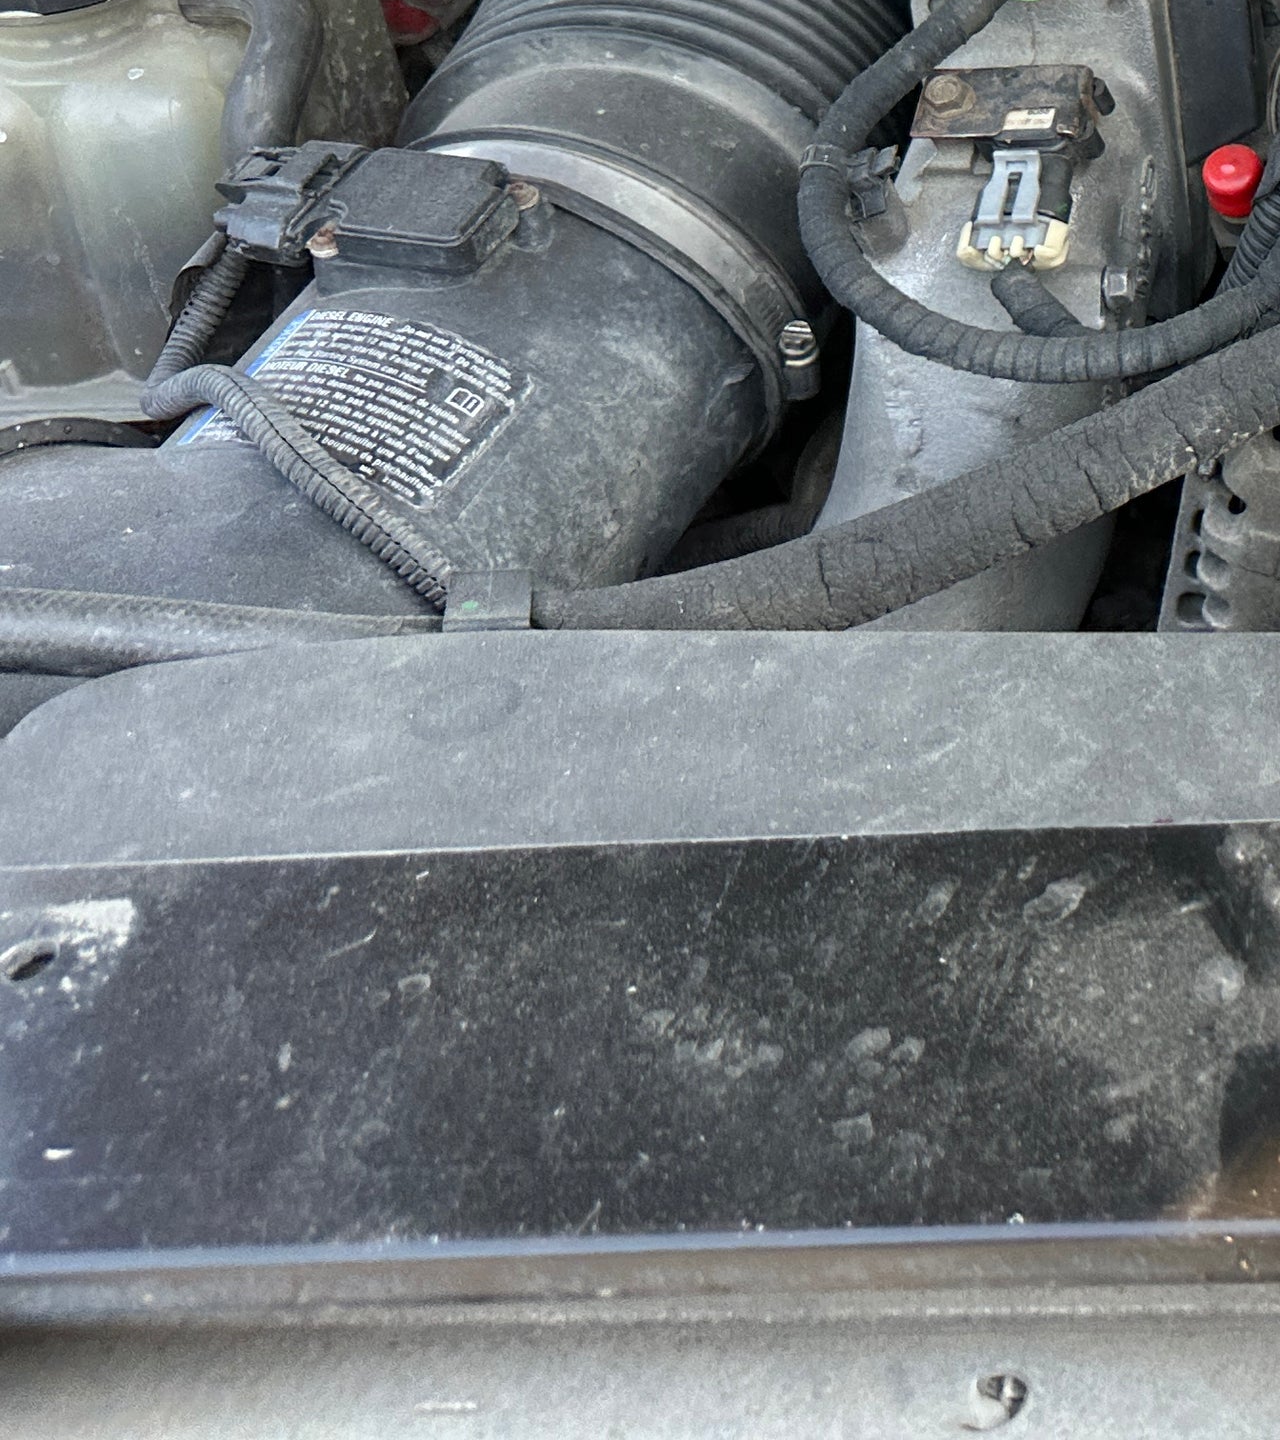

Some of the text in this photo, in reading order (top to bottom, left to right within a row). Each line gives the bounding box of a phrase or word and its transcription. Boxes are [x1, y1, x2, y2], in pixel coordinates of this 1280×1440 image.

[309, 310, 348, 321] DIESEL
[346, 311, 395, 328] ENGINE
[305, 361, 350, 379] DIESEL
[320, 435, 360, 457] bougies
